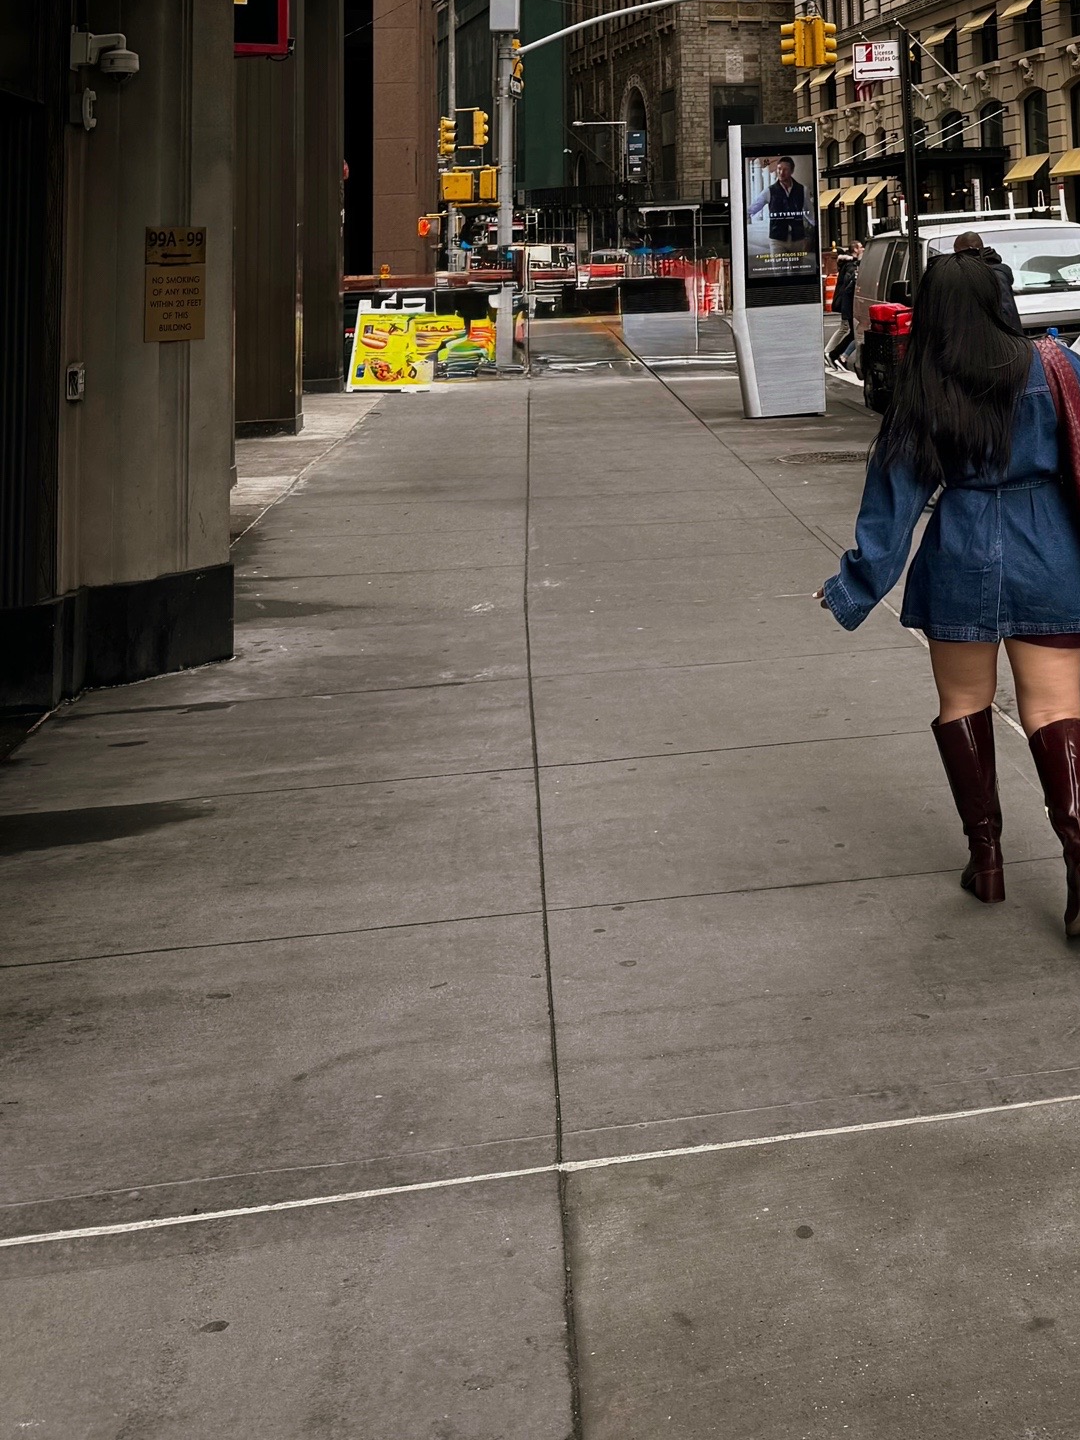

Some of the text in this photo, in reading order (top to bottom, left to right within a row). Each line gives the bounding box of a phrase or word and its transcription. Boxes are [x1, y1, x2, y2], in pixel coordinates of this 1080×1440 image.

[785, 125, 812, 133] LinkNYC
[151, 276, 200, 285] NO SMOKING
[165, 288, 180, 296] ANY
[150, 300, 174, 308] WITHIN
[187, 299, 202, 307] FEET
[162, 311, 189, 320] OF THIS
[158, 323, 192, 332] BUILDING
